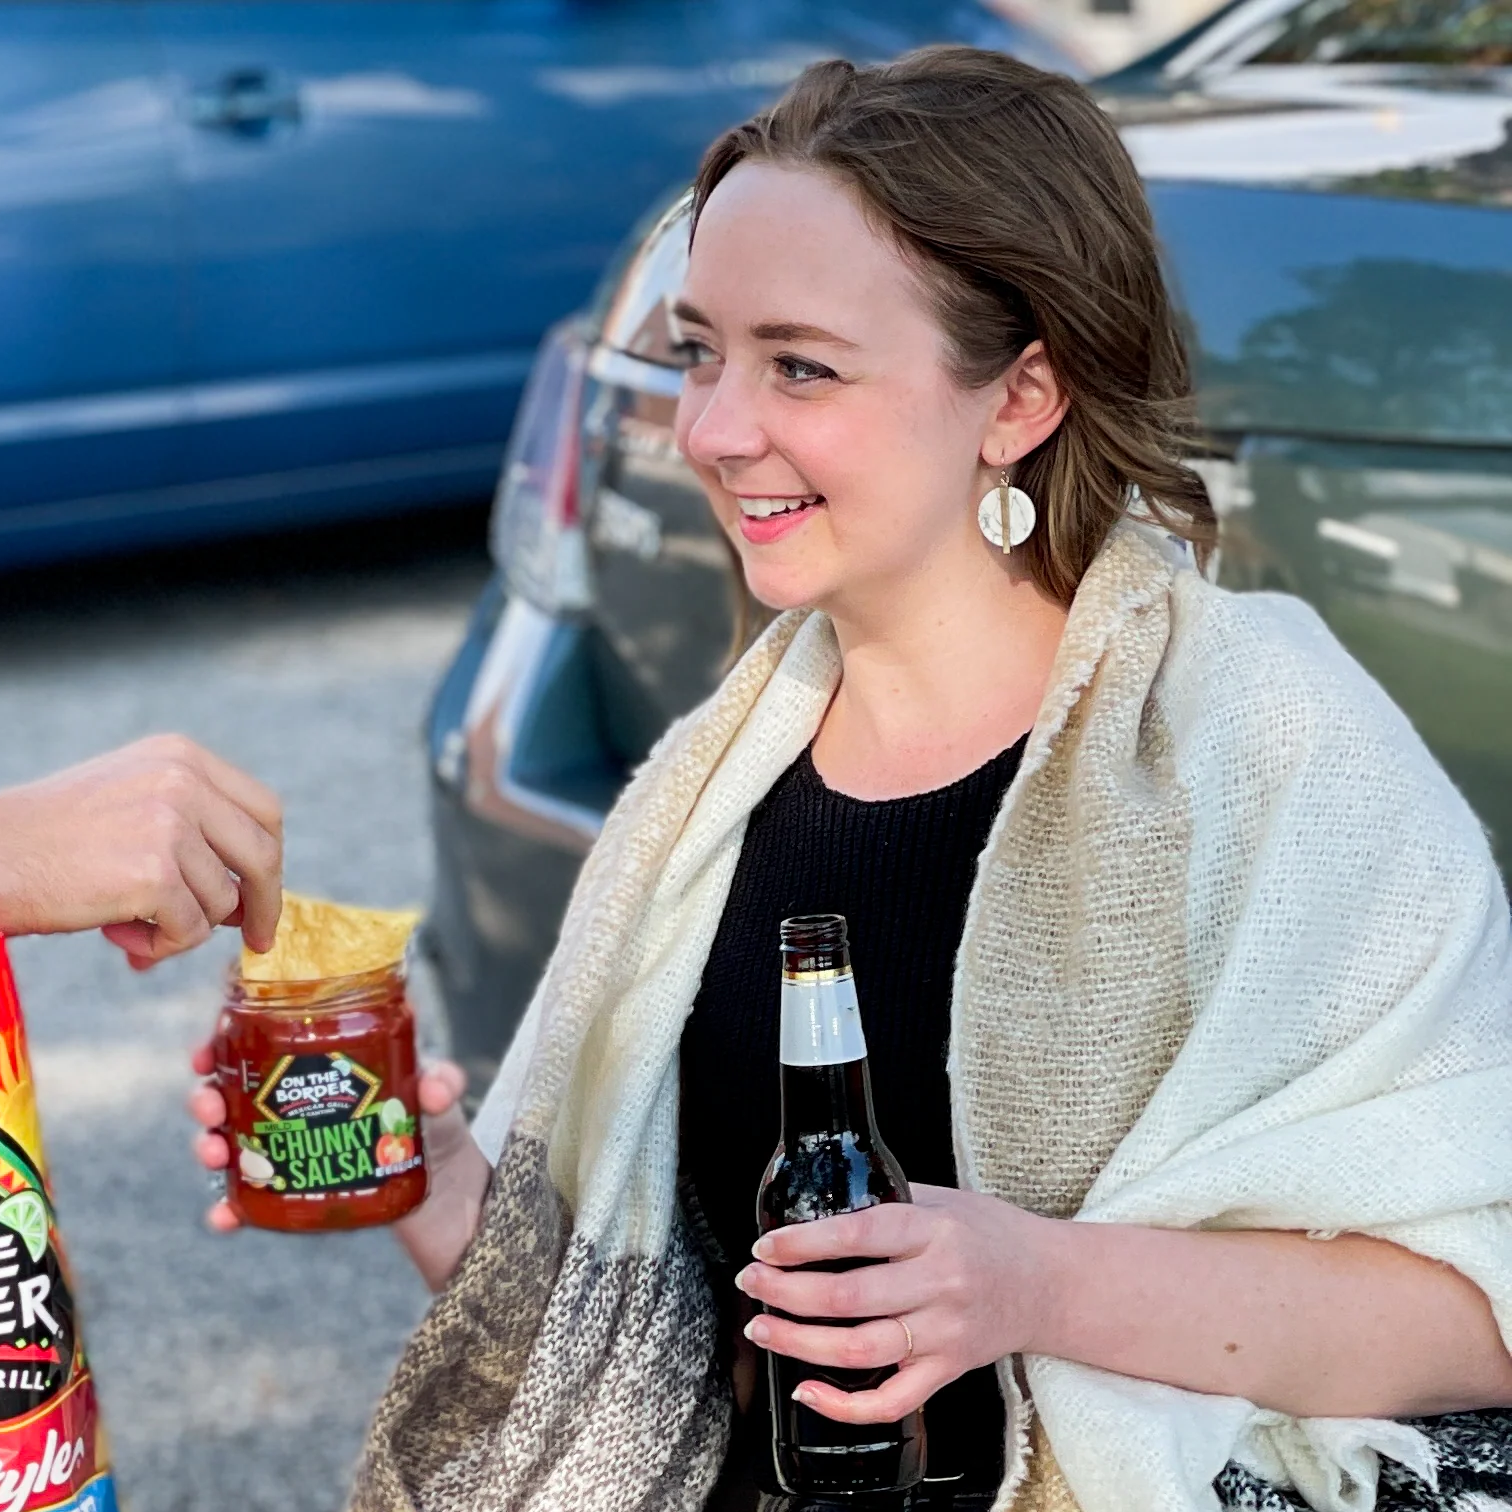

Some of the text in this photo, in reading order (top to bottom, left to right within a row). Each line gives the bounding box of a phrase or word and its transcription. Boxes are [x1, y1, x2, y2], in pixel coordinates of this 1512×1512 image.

[280, 1071, 340, 1088] ON THE
[275, 1080, 357, 1103] BORDER
[264, 1122, 292, 1132] MILD
[269, 1117, 373, 1162] CHUNKY
[289, 1148, 373, 1189] SALSA
